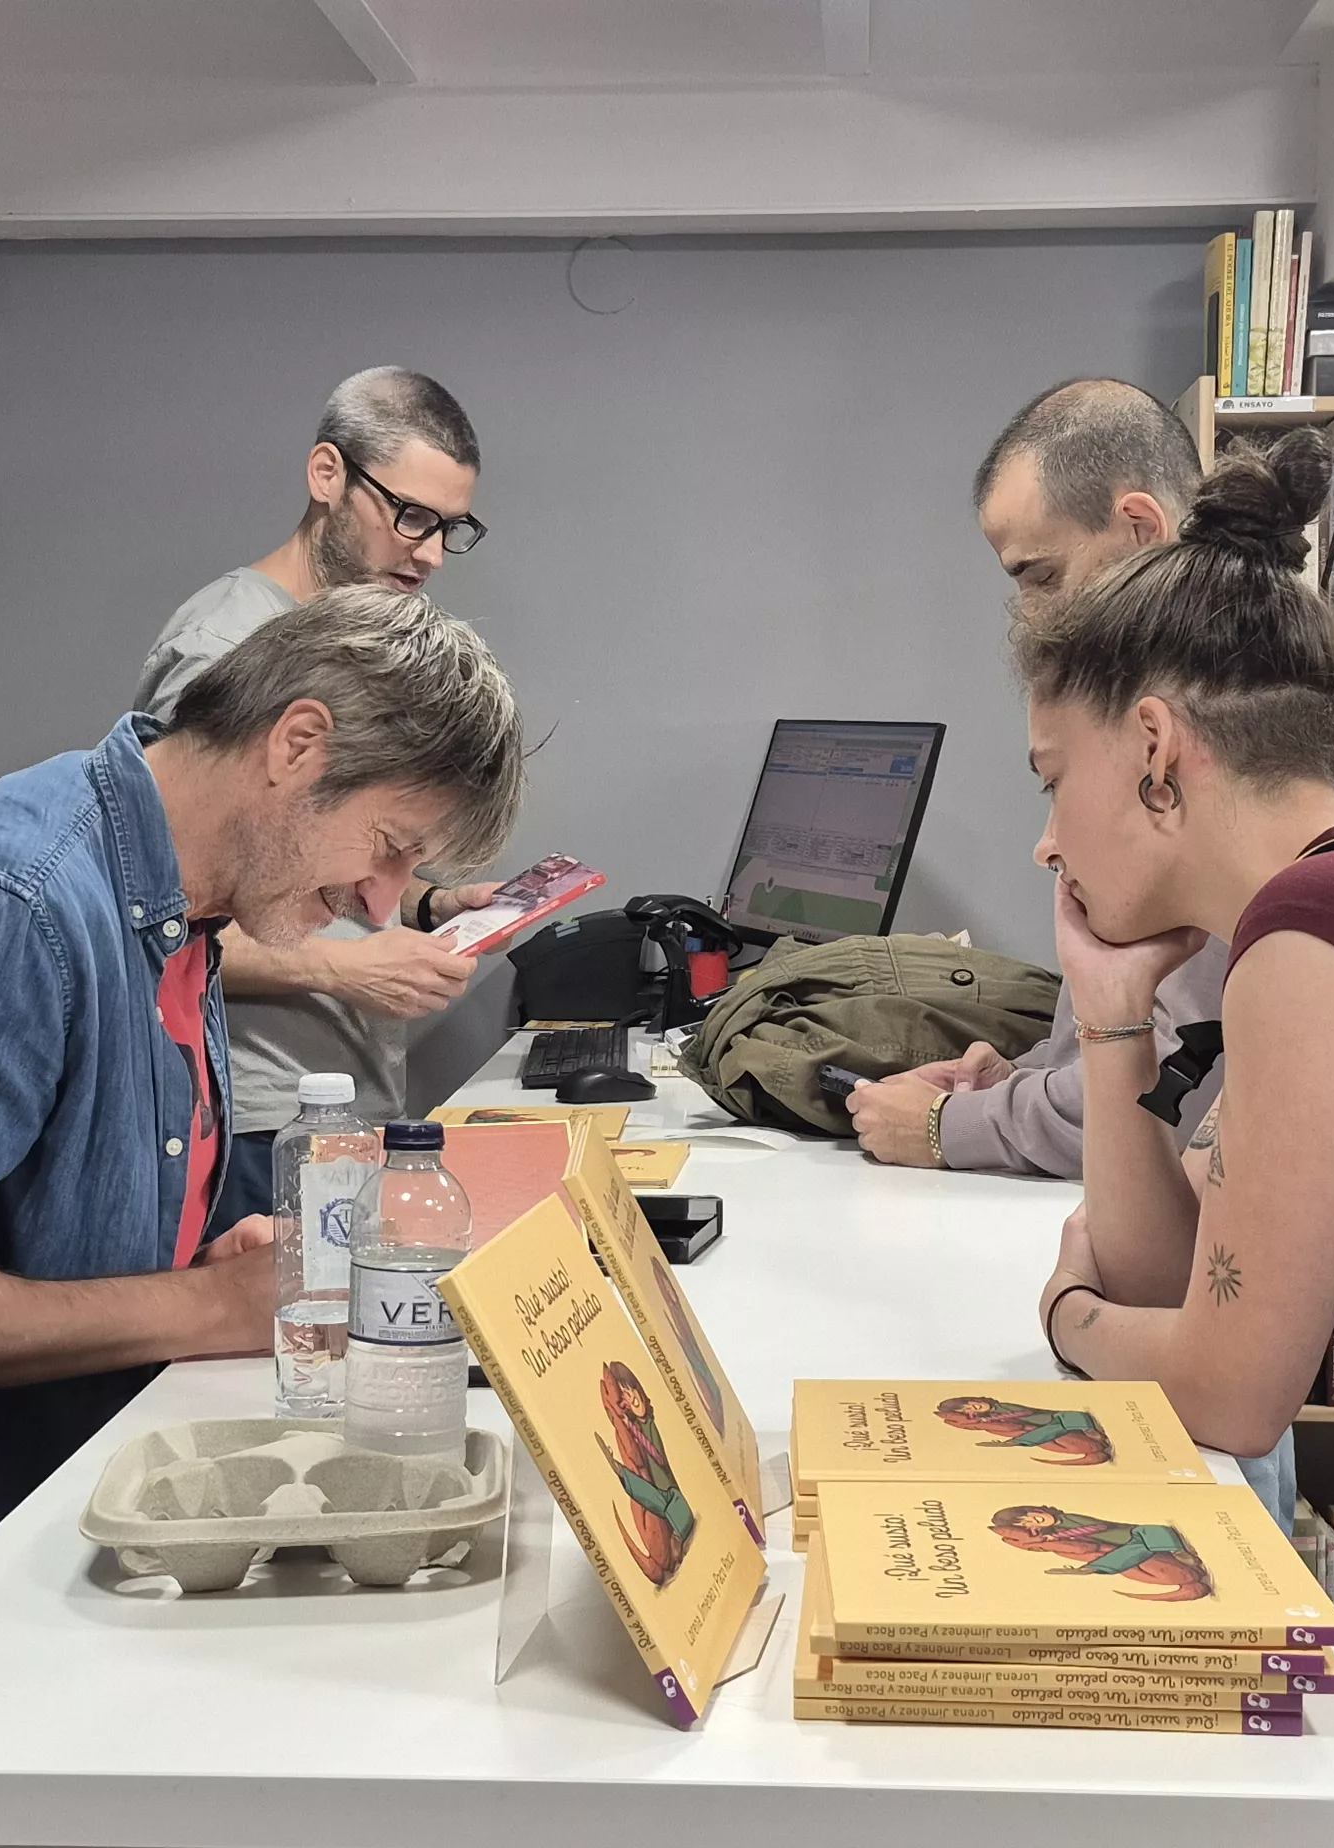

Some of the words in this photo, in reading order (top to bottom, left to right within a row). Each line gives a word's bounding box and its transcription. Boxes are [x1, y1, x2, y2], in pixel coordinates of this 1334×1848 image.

[578, 1197, 593, 1222] Roca
[590, 1222, 606, 1246] Paco
[602, 1245, 613, 1253] y
[514, 1282, 546, 1338] ¡Qué
[541, 1257, 574, 1312] susto!
[380, 1300, 455, 1326] VER
[626, 1291, 648, 1325] Lorena
[457, 1305, 476, 1334] Roca
[520, 1343, 552, 1378] Un
[545, 1320, 573, 1362] beso
[569, 1288, 603, 1348] peludo
[472, 1335, 492, 1363] Paco
[648, 1334, 675, 1375] peludo
[487, 1358, 500, 1369] y
[493, 1371, 523, 1416] Jiménez
[669, 1374, 686, 1403] beso
[683, 1401, 696, 1425] Un
[839, 1402, 869, 1428] susto!
[873, 1392, 913, 1423] peludo
[519, 1419, 545, 1458] Lorena
[690, 1423, 715, 1458] susto!
[842, 1431, 881, 1452] ¡Qué
[879, 1423, 908, 1446] beso
[882, 1445, 912, 1464] Un
[547, 1468, 582, 1518] peludo
[913, 1499, 965, 1541] peludo
[575, 1518, 596, 1552] beso
[873, 1513, 912, 1549] susto!
[593, 1550, 610, 1578] Un
[883, 1552, 930, 1582] ¡Qué
[927, 1543, 963, 1573] beso
[935, 1573, 971, 1599] Un
[603, 1576, 635, 1619] susto!
[628, 1620, 657, 1653] ¡Qué
[865, 1625, 894, 1637] Roca
[896, 1625, 925, 1637] Paco
[930, 1622, 941, 1635] y
[940, 1626, 993, 1639] Jiménez
[995, 1627, 1038, 1639] Lorena
[1055, 1624, 1109, 1640] peludo
[1111, 1627, 1146, 1642] beso
[1148, 1627, 1176, 1642] Un
[1179, 1628, 1224, 1643] susto!
[1228, 1626, 1264, 1644] ¡Qué
[838, 1641, 868, 1653] Roca
[871, 1642, 898, 1655] Paco
[903, 1641, 913, 1653] y
[911, 1643, 965, 1658] Jiménez
[967, 1646, 1011, 1659] Lorena
[1028, 1644, 1081, 1663] peludo
[1084, 1650, 1119, 1666] beso
[1121, 1652, 1150, 1668] Un
[1152, 1653, 1200, 1669] susto!
[1203, 1652, 1238, 1670] ¡Qué
[823, 1704, 854, 1717] Roca
[855, 1705, 886, 1718] Paco
[889, 1703, 900, 1715] y
[899, 1705, 949, 1721] Jiménez
[951, 1708, 995, 1721] Lorena
[1011, 1706, 1066, 1724] peludo
[1067, 1710, 1101, 1726] beso
[1103, 1712, 1132, 1727] Un
[1134, 1713, 1179, 1728] susto!
[1182, 1711, 1219, 1728] ¡Qué
